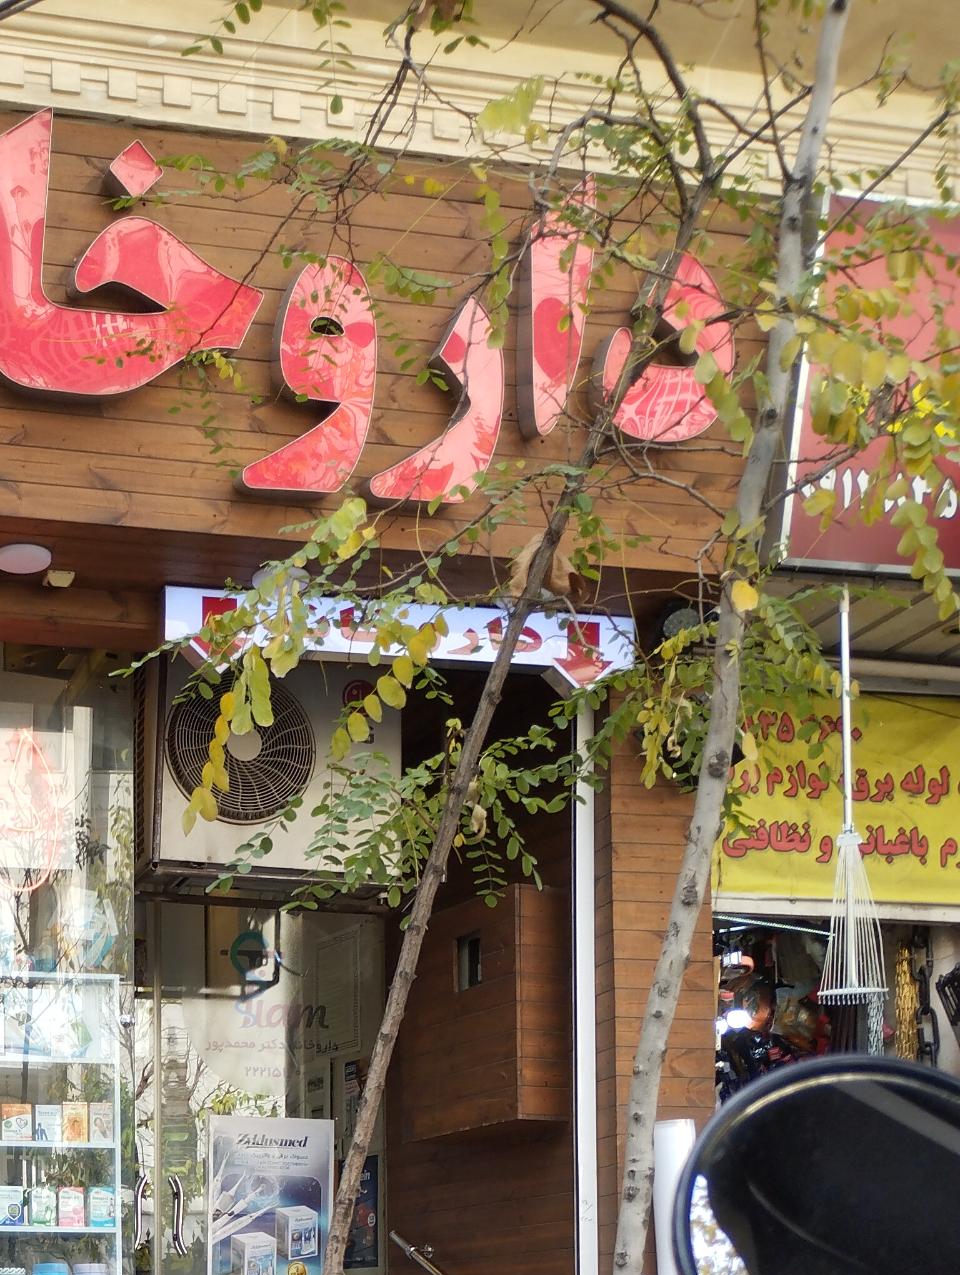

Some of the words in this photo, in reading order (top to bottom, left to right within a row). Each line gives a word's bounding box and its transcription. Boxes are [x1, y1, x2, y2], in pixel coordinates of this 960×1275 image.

[900, 764, 951, 805] لوله
[816, 834, 834, 864] و
[855, 824, 929, 866] باغبان
